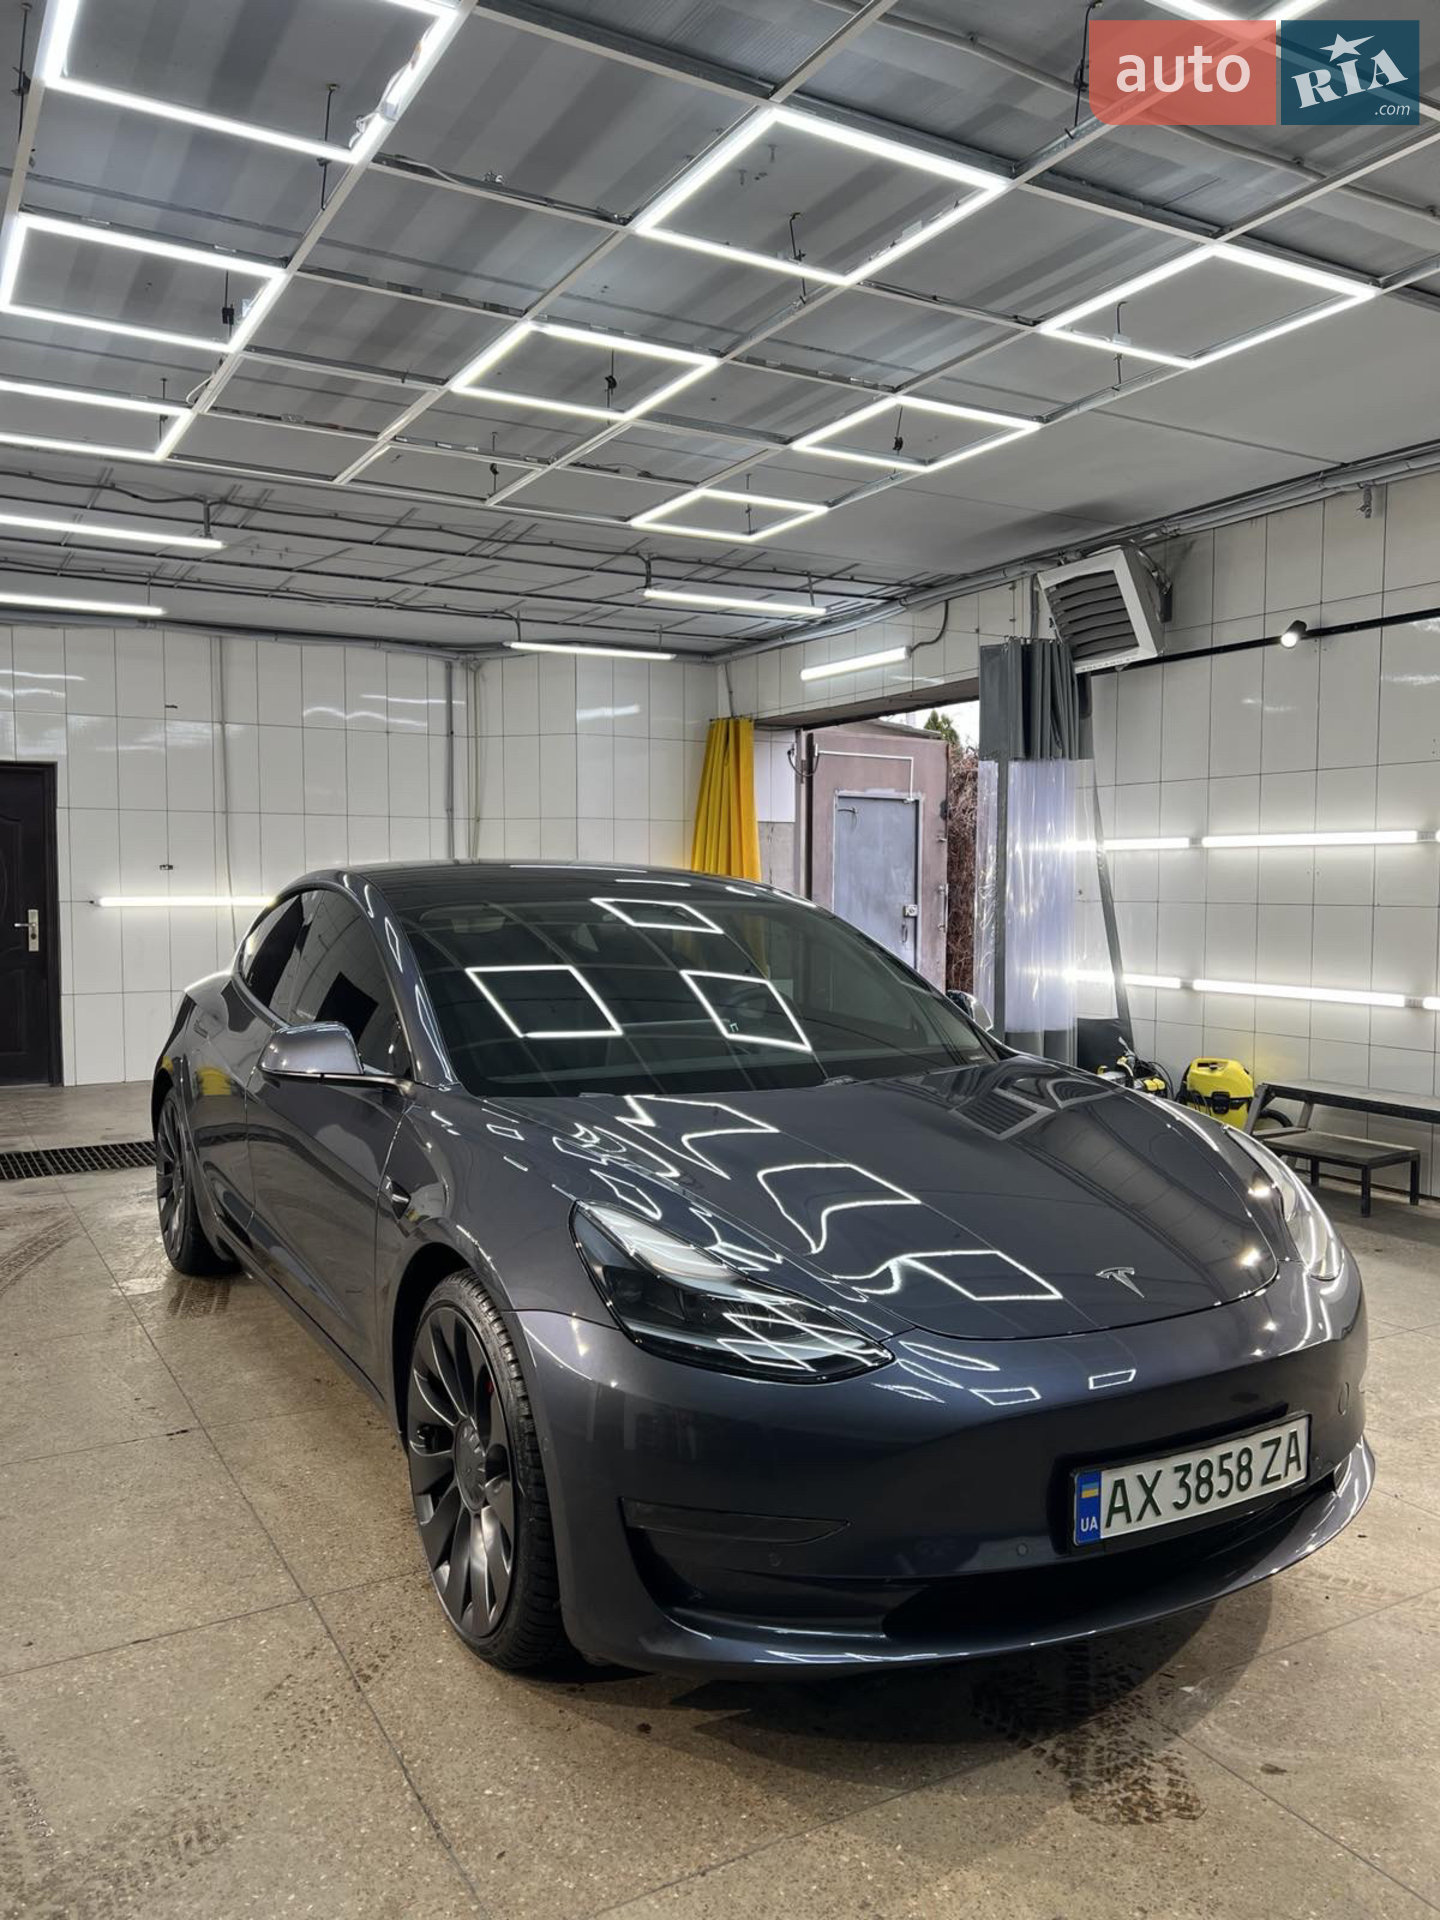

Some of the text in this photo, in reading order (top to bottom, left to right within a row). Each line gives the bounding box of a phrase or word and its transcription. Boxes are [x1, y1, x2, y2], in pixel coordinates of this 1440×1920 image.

[1105, 1429, 1302, 1529] AX 3858 ZA
[1080, 1517, 1098, 1533] UA
